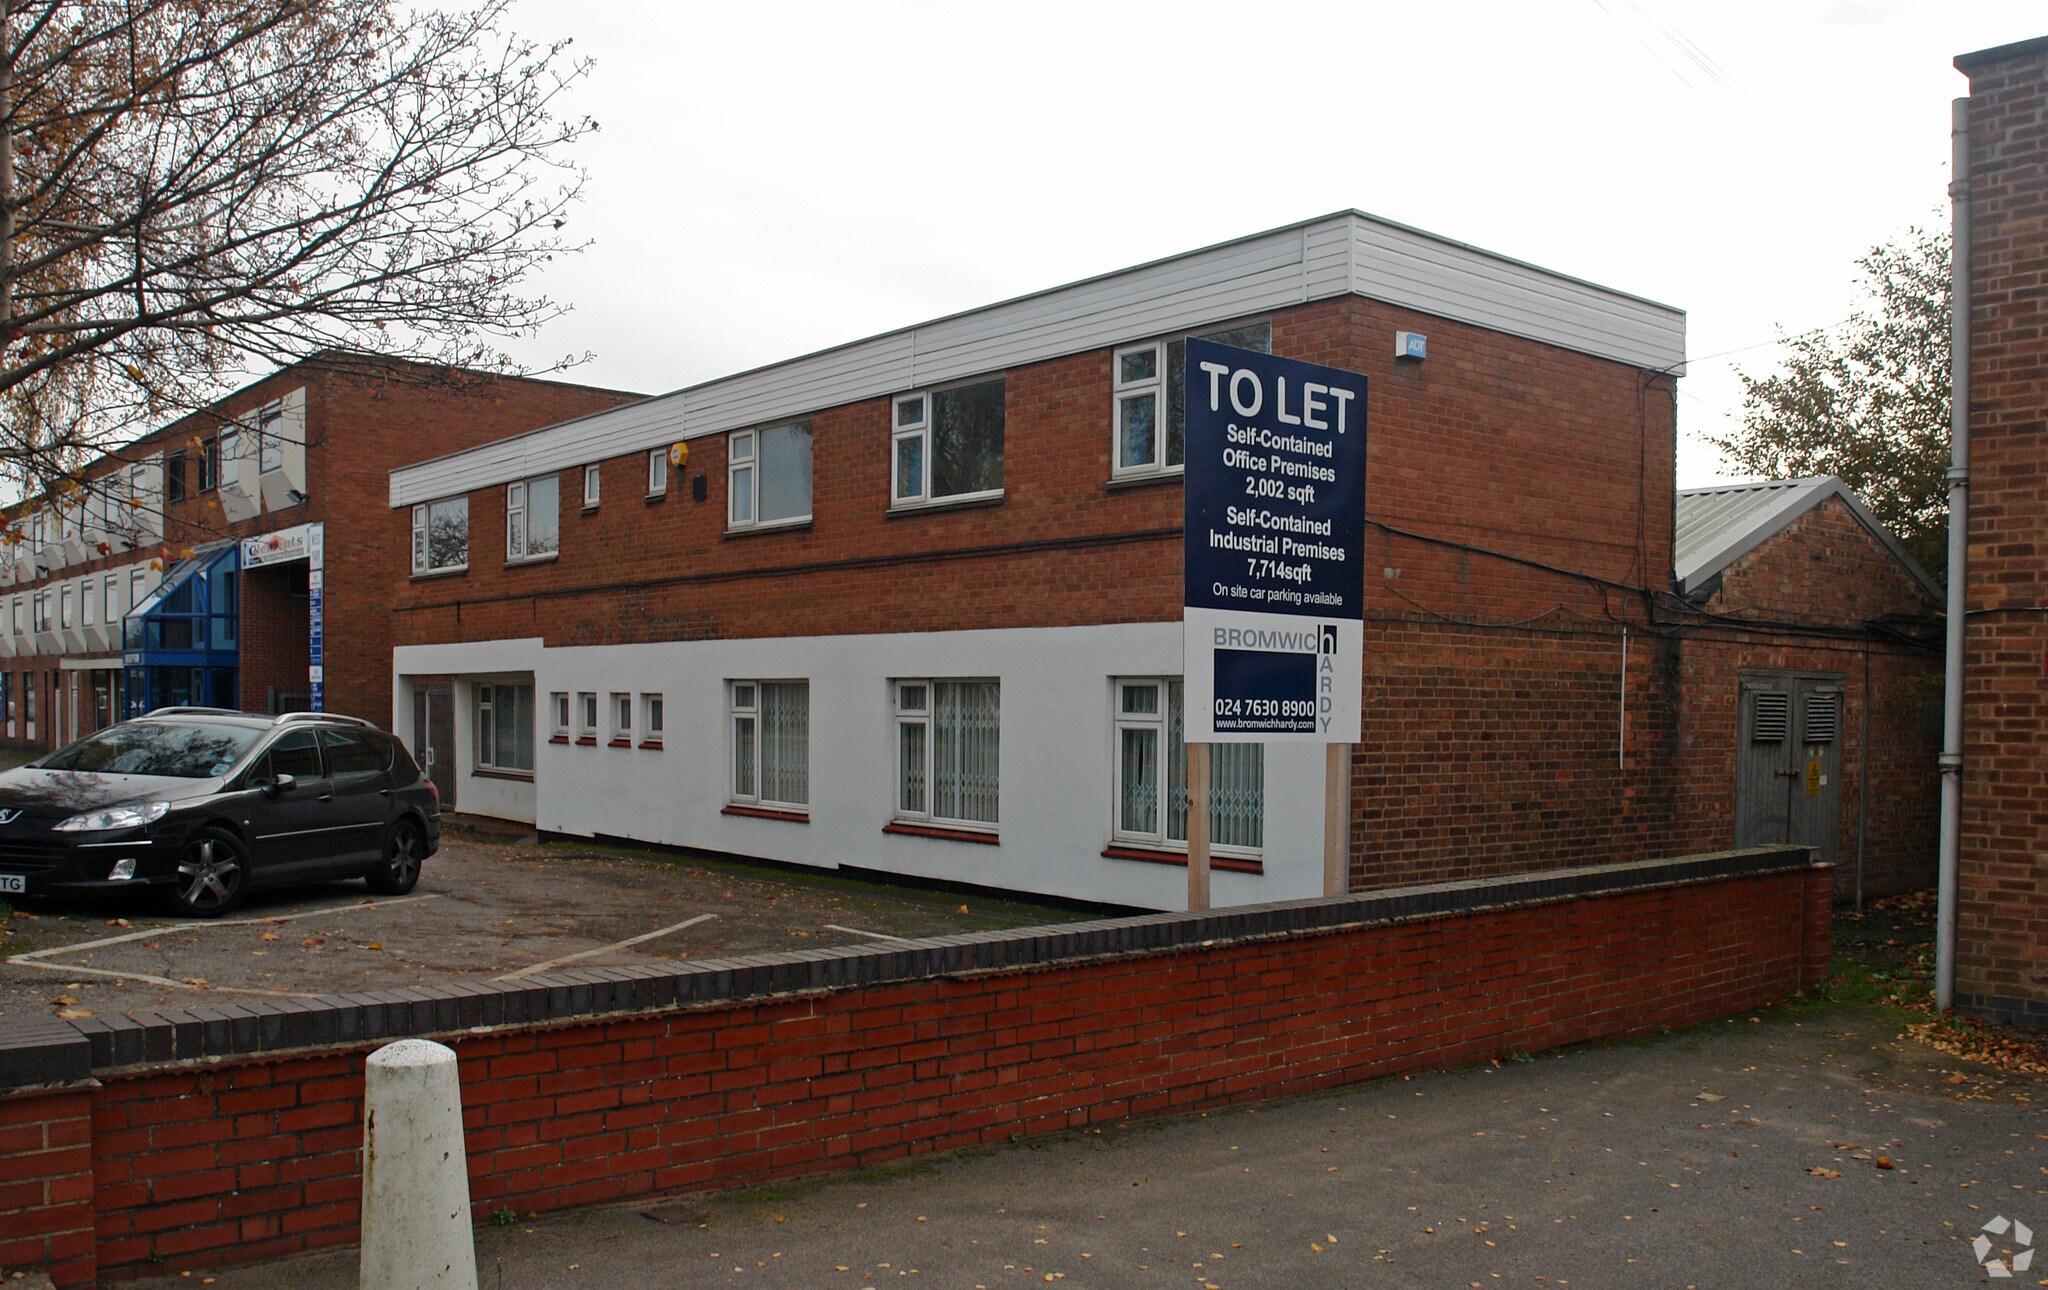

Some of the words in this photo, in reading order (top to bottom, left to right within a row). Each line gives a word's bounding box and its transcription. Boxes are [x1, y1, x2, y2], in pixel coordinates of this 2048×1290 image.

[1200, 361, 1263, 417] TO
[1277, 376, 1355, 434] LET
[1227, 424, 1333, 458] Self-Contained
[1223, 448, 1267, 471] Office
[1271, 455, 1336, 482] Premises
[1246, 477, 1285, 498] 2,002
[1287, 485, 1315, 505] sqft
[1226, 506, 1331, 536] Self-Contained
[1209, 529, 1279, 554] Industrial
[1282, 537, 1346, 561] Premises
[1247, 558, 1312, 584] 7,714sqft
[1213, 582, 1228, 597] On
[1230, 585, 1248, 598] site
[1250, 588, 1266, 599] car
[1267, 589, 1302, 604] parking
[1303, 591, 1343, 606] available
[1215, 699, 1242, 716] 024
[1245, 699, 1279, 716] 7630
[1282, 700, 1315, 717] 8900
[1216, 718, 1315, 731] www.bromwichhardy.com
